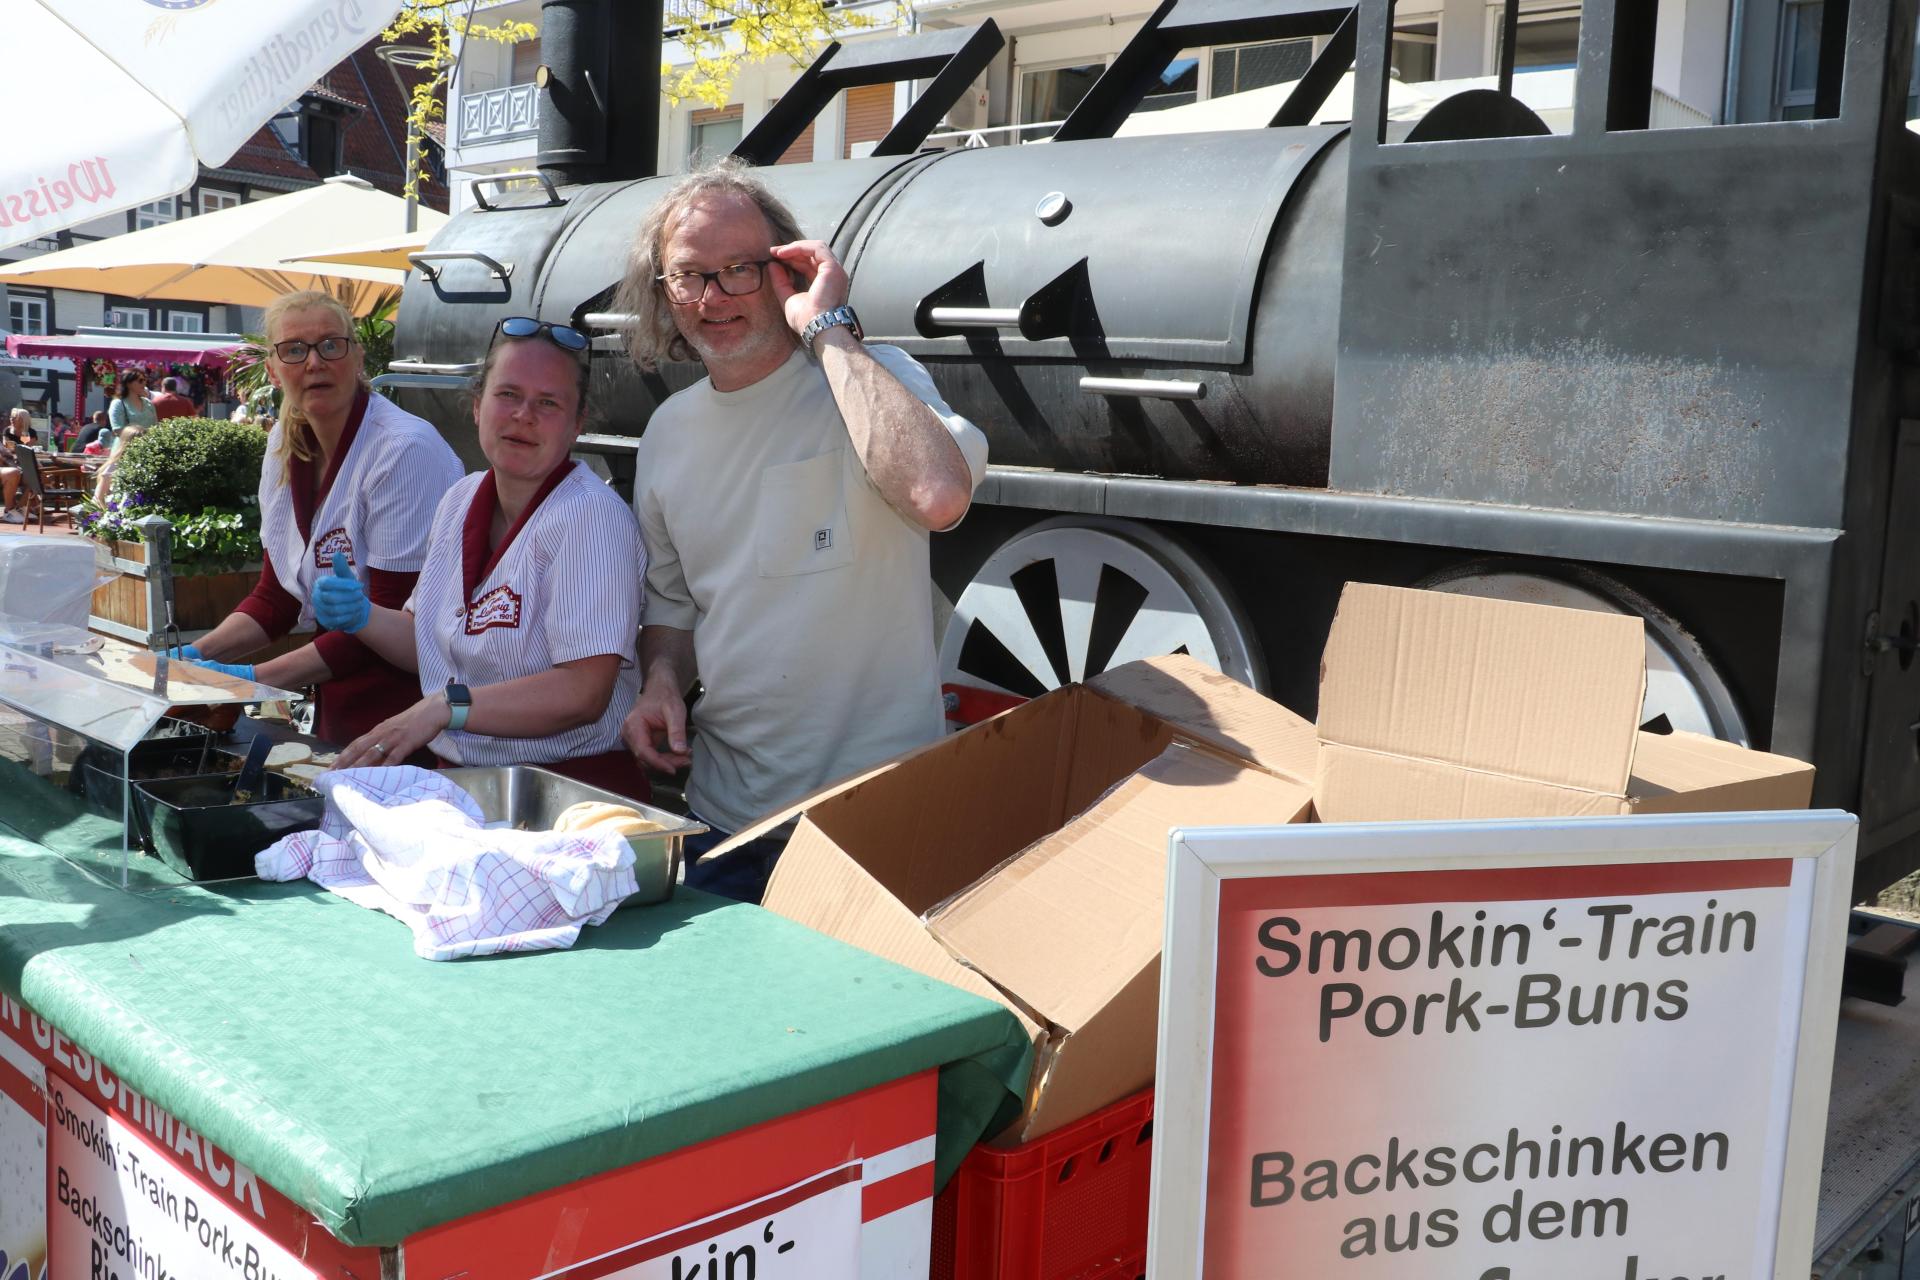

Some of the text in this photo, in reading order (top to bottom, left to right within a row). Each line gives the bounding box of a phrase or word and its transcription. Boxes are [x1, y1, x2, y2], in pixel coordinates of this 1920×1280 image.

[1318, 972, 1690, 1042] Pork-Buns
[1248, 1121, 1730, 1208] Backschinken
[57, 1165, 177, 1280] Backschink
[1339, 1188, 1630, 1258] aus dem
